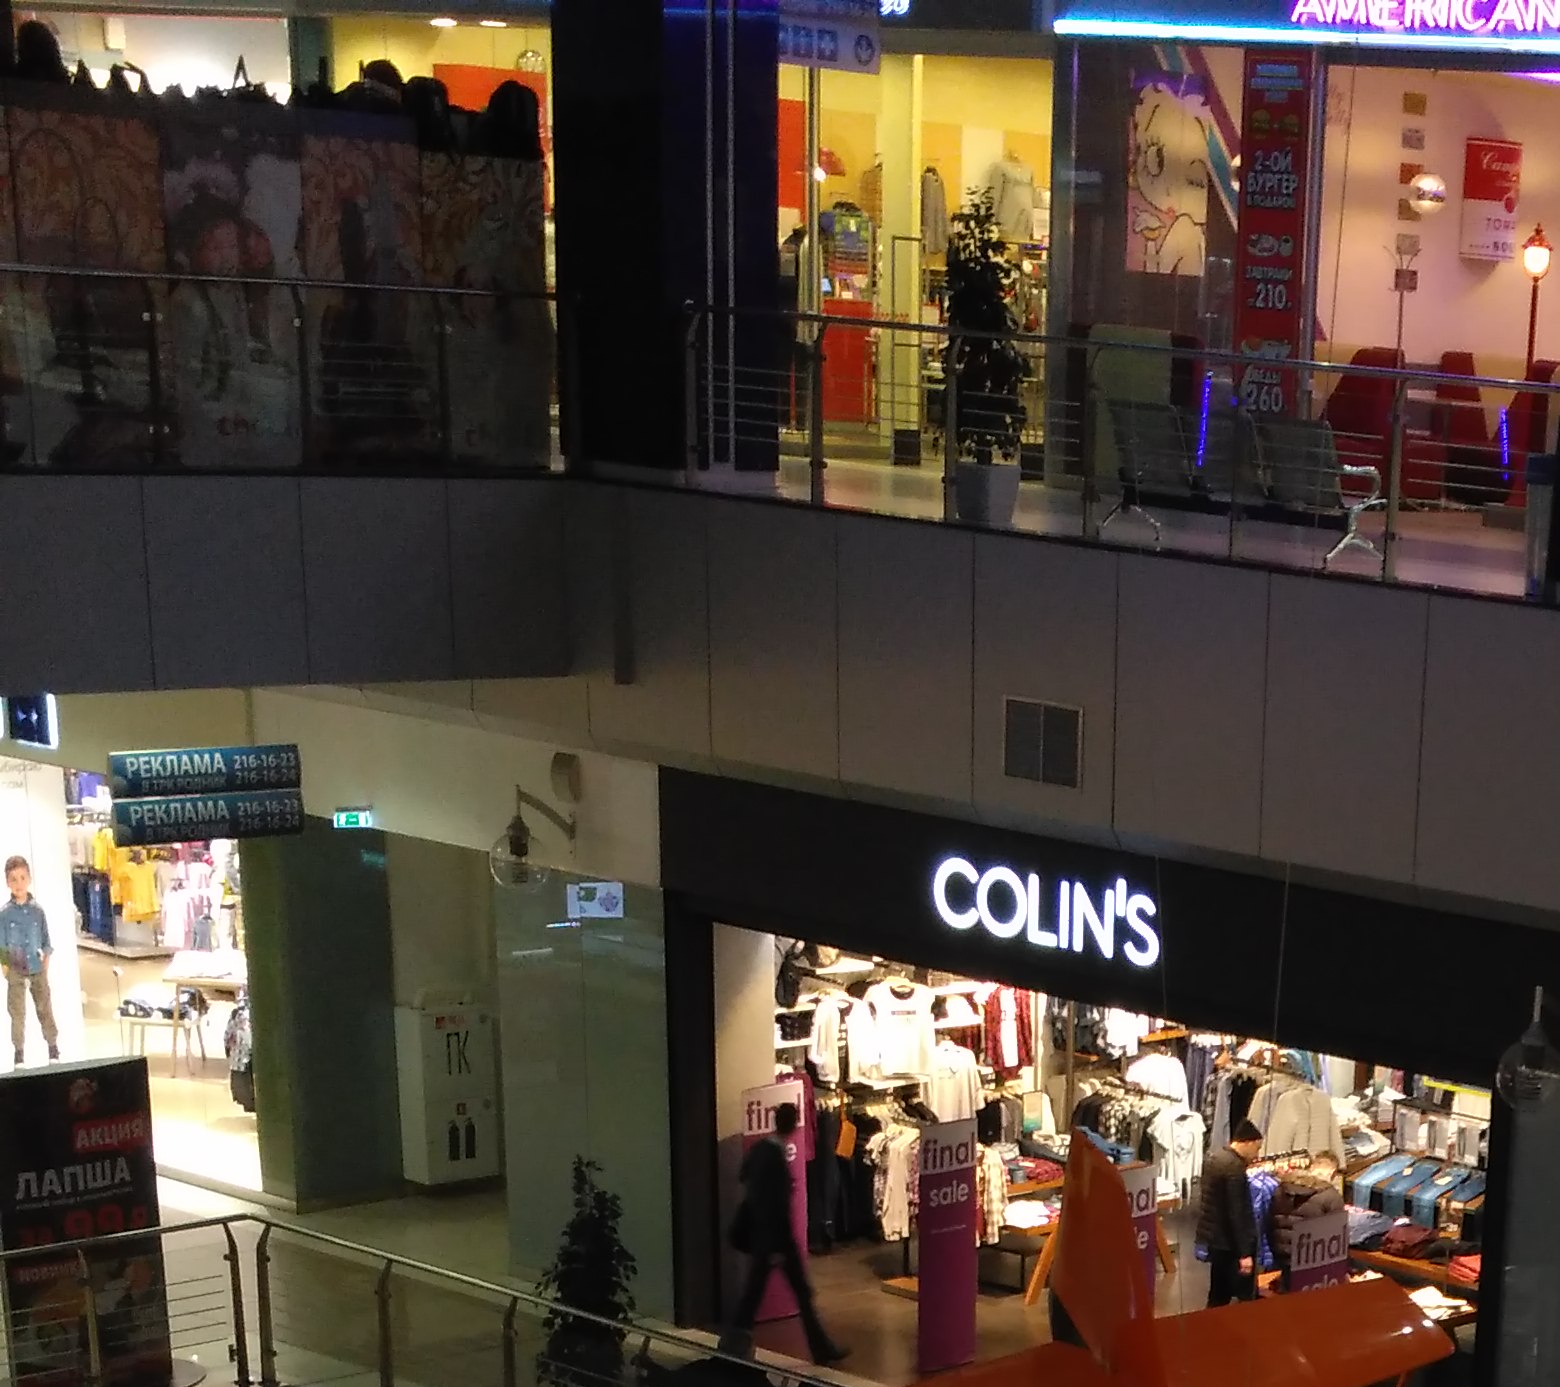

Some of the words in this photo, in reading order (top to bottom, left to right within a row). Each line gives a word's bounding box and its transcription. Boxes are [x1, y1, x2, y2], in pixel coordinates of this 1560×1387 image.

[125, 752, 227, 780] РЕКЛАМА
[233, 753, 296, 770] 216-16-23
[130, 799, 230, 826] РЕКЛАМА
[933, 856, 1161, 967] COLIN'S
[446, 1030, 471, 1076] ПК
[746, 1091, 801, 1131] finl
[76, 1118, 145, 1149] АКЦИЯ
[922, 1131, 976, 1170] final
[15, 1156, 132, 1201] ЛАПША
[929, 1179, 969, 1208] sale
[1296, 1223, 1348, 1266] final
